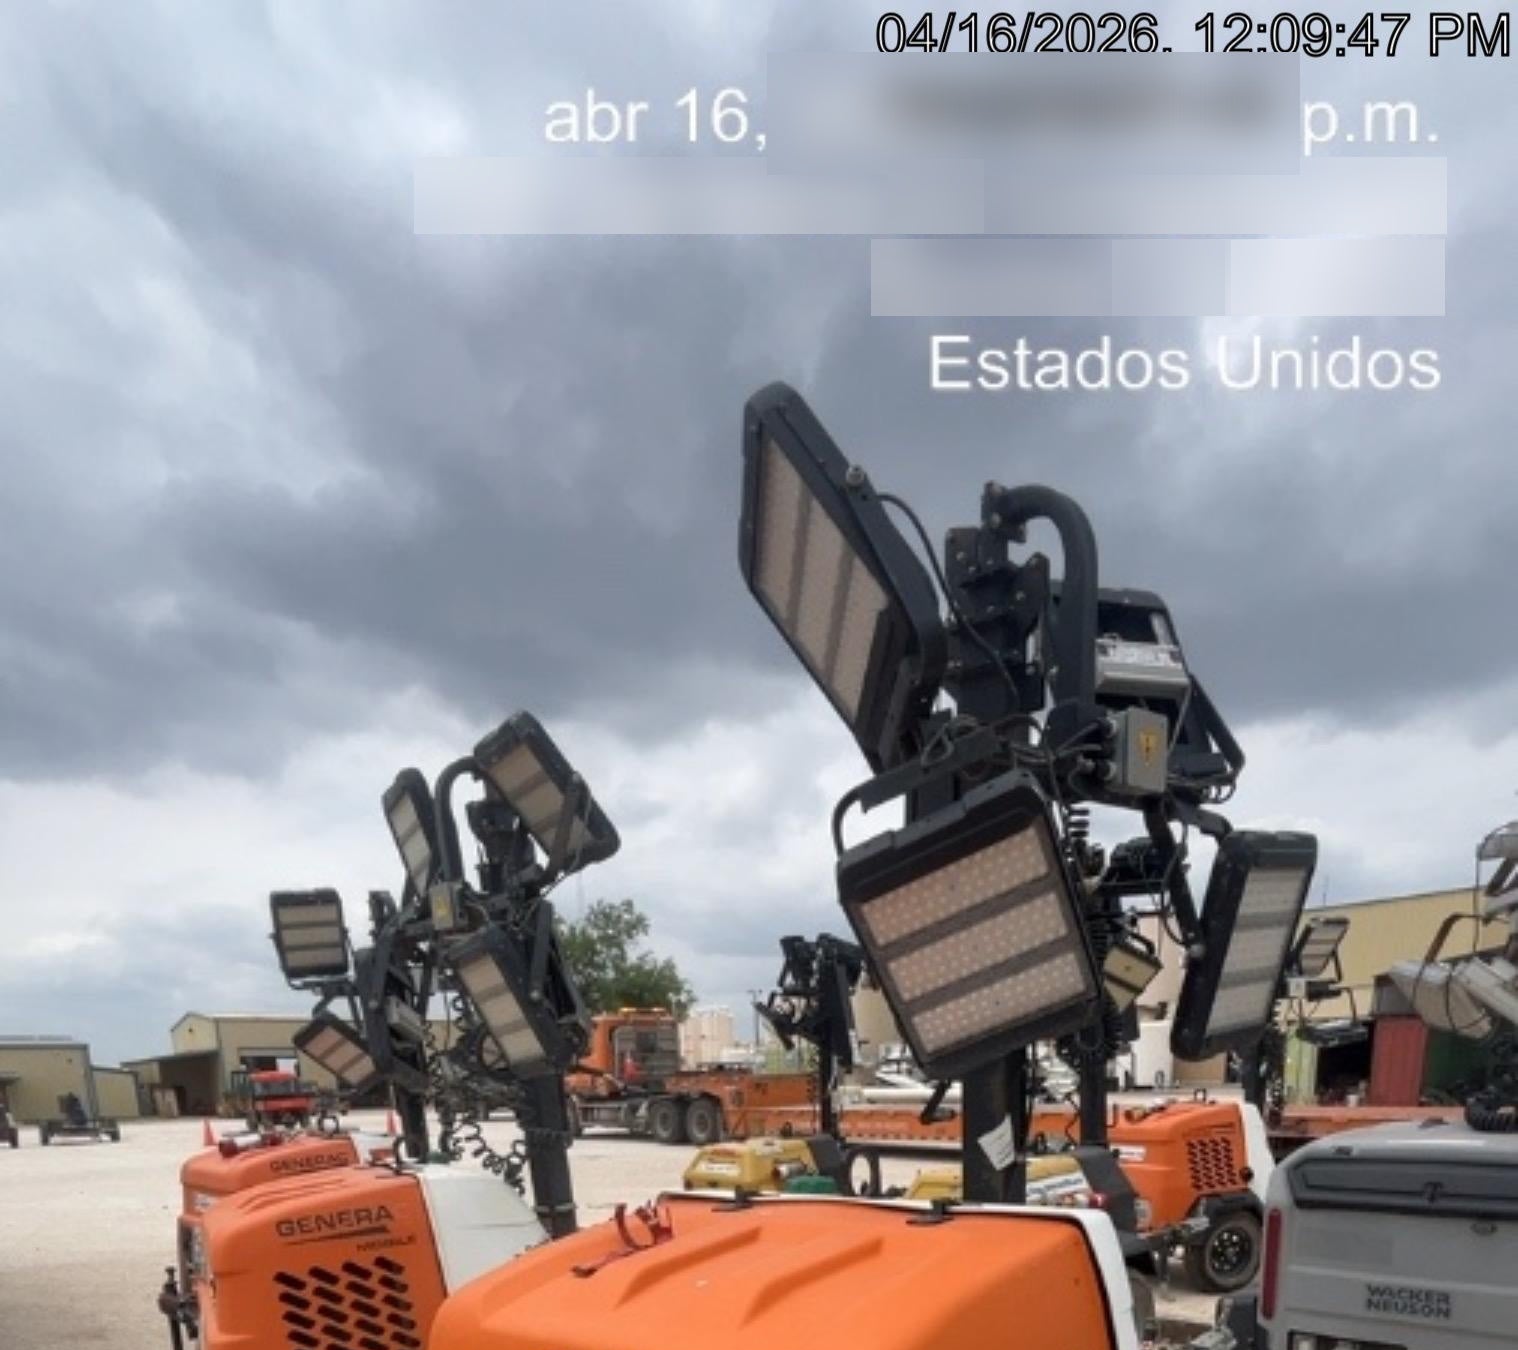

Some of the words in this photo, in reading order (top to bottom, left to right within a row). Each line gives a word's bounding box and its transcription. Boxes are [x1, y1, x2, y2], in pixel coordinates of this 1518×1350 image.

[276, 1205, 394, 1237] GENERA
[1366, 1284, 1449, 1305] WACKER
[1366, 1297, 1450, 1319] NEUSON
